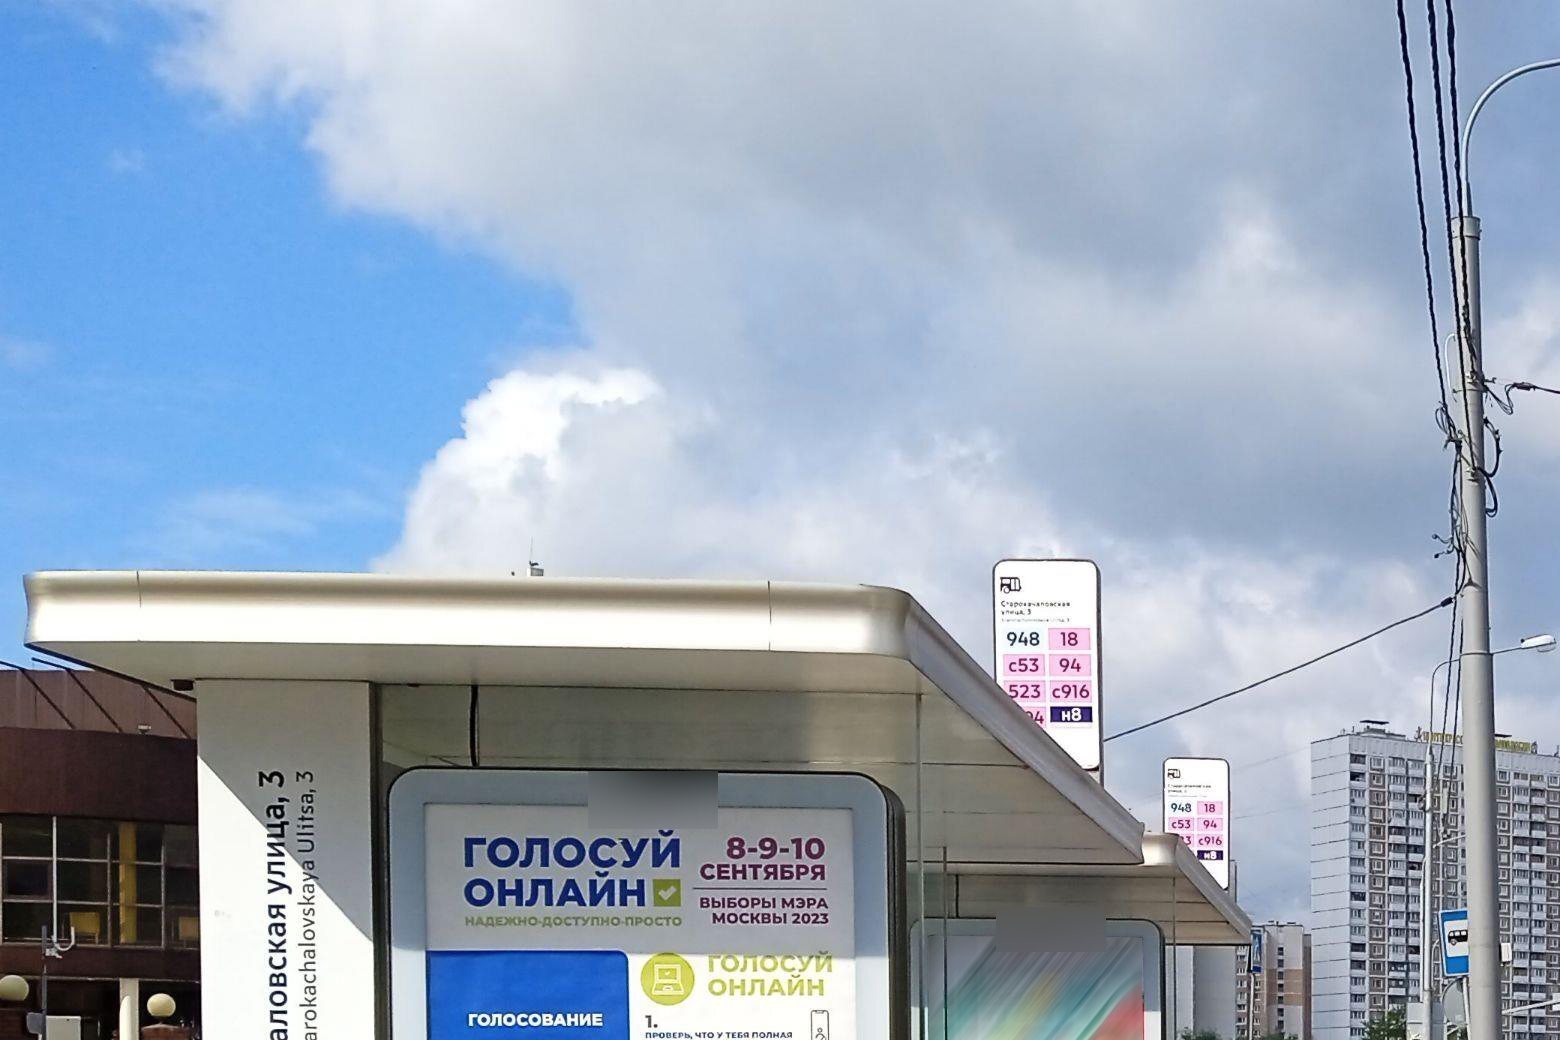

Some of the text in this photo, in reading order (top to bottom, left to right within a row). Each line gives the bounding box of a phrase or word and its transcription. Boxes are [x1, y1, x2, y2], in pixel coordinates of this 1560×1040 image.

[1007, 632, 1079, 646] 948 18
[1059, 658, 1082, 672] 94
[1009, 685, 1041, 698] 523
[258, 769, 284, 788] 3
[296, 770, 314, 783] 3
[1171, 803, 1216, 812] 948 18
[297, 788, 317, 853] Ulitsa,
[1203, 820, 1217, 829] 94
[266, 796, 293, 895] улица,
[464, 830, 681, 869] ГОЛОСУЙ
[726, 837, 826, 860] 8-9-10
[700, 863, 826, 881] СЕНТЯБРЯ
[464, 871, 646, 907] ОНЛАЙН
[700, 897, 828, 909] ВЫБОРЫ МЭРА
[712, 913, 829, 924] МОСКВЫ 2023
[708, 951, 833, 973] ГОЛОСУЙ
[708, 974, 825, 996] ОНЛАЙН
[468, 1013, 604, 1027] ГОЛОСОВАНИЕ
[645, 1015, 658, 1028] 1.
